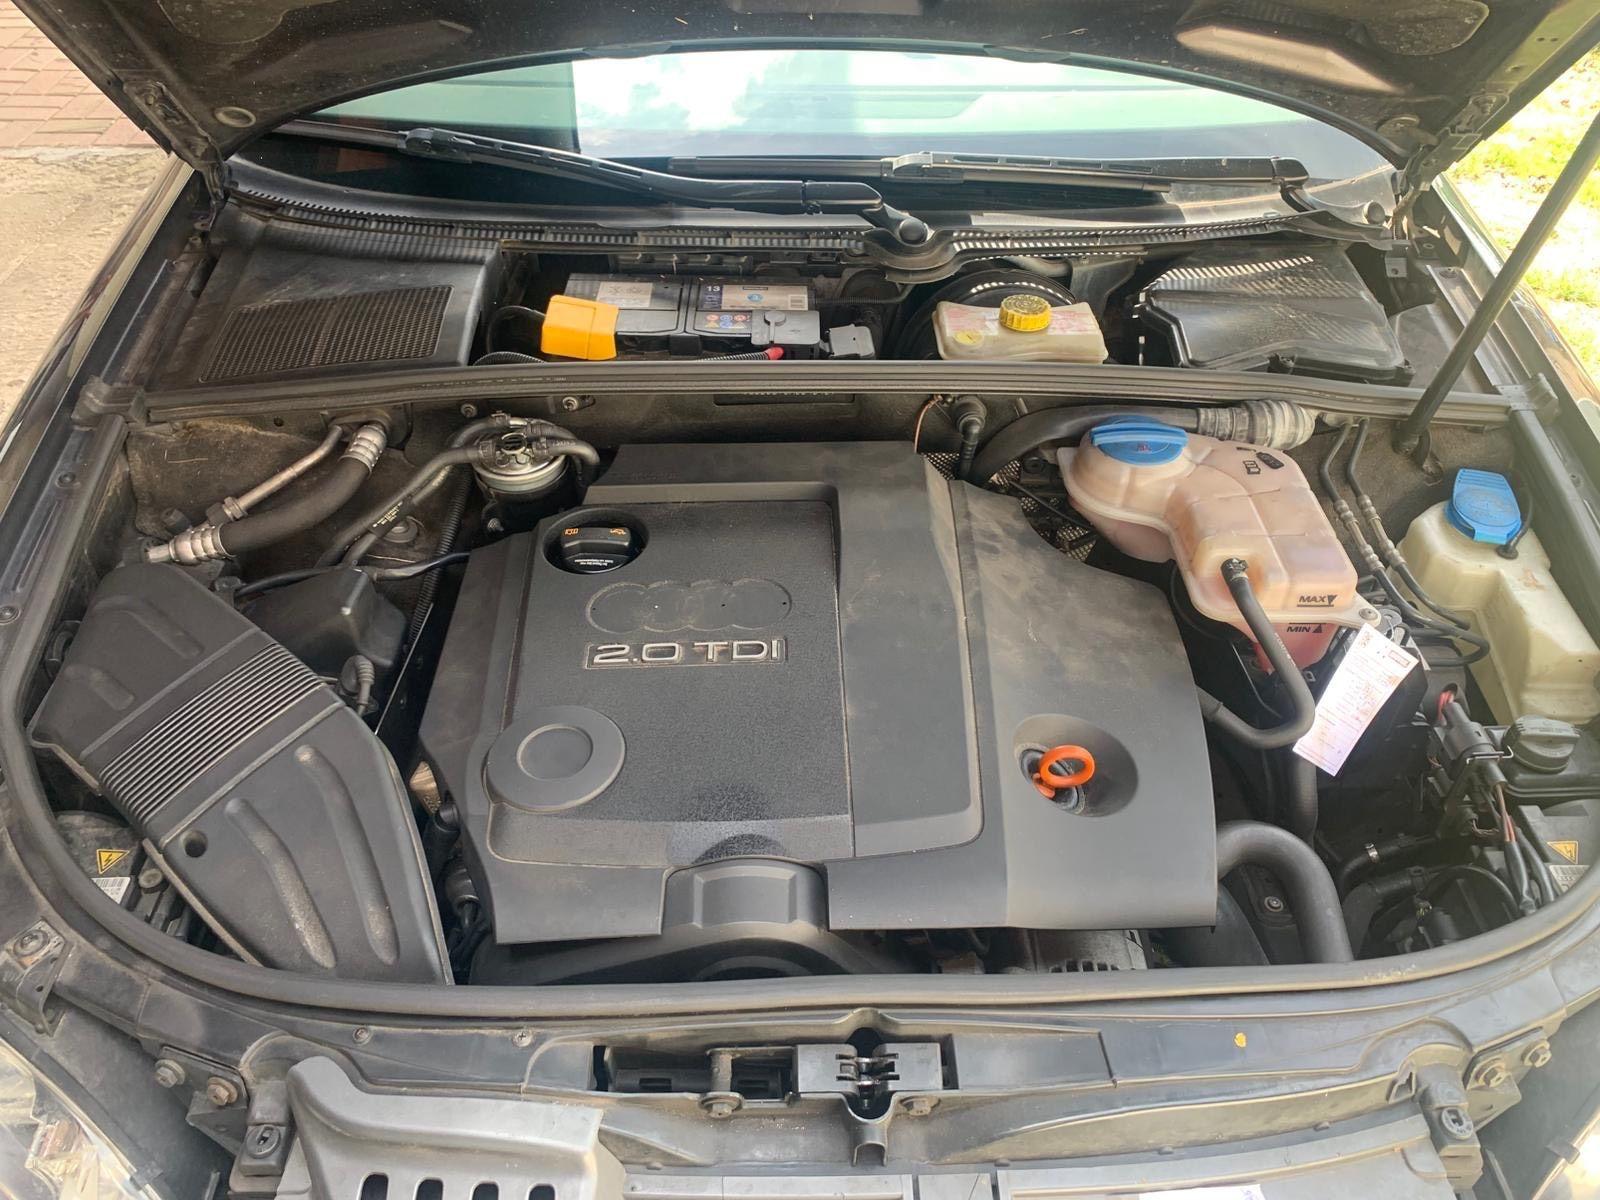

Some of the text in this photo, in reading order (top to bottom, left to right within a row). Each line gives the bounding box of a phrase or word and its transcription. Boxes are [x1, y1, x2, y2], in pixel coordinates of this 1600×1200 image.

[1298, 595, 1327, 603] MAX
[593, 639, 778, 664] 2.0 TDI
